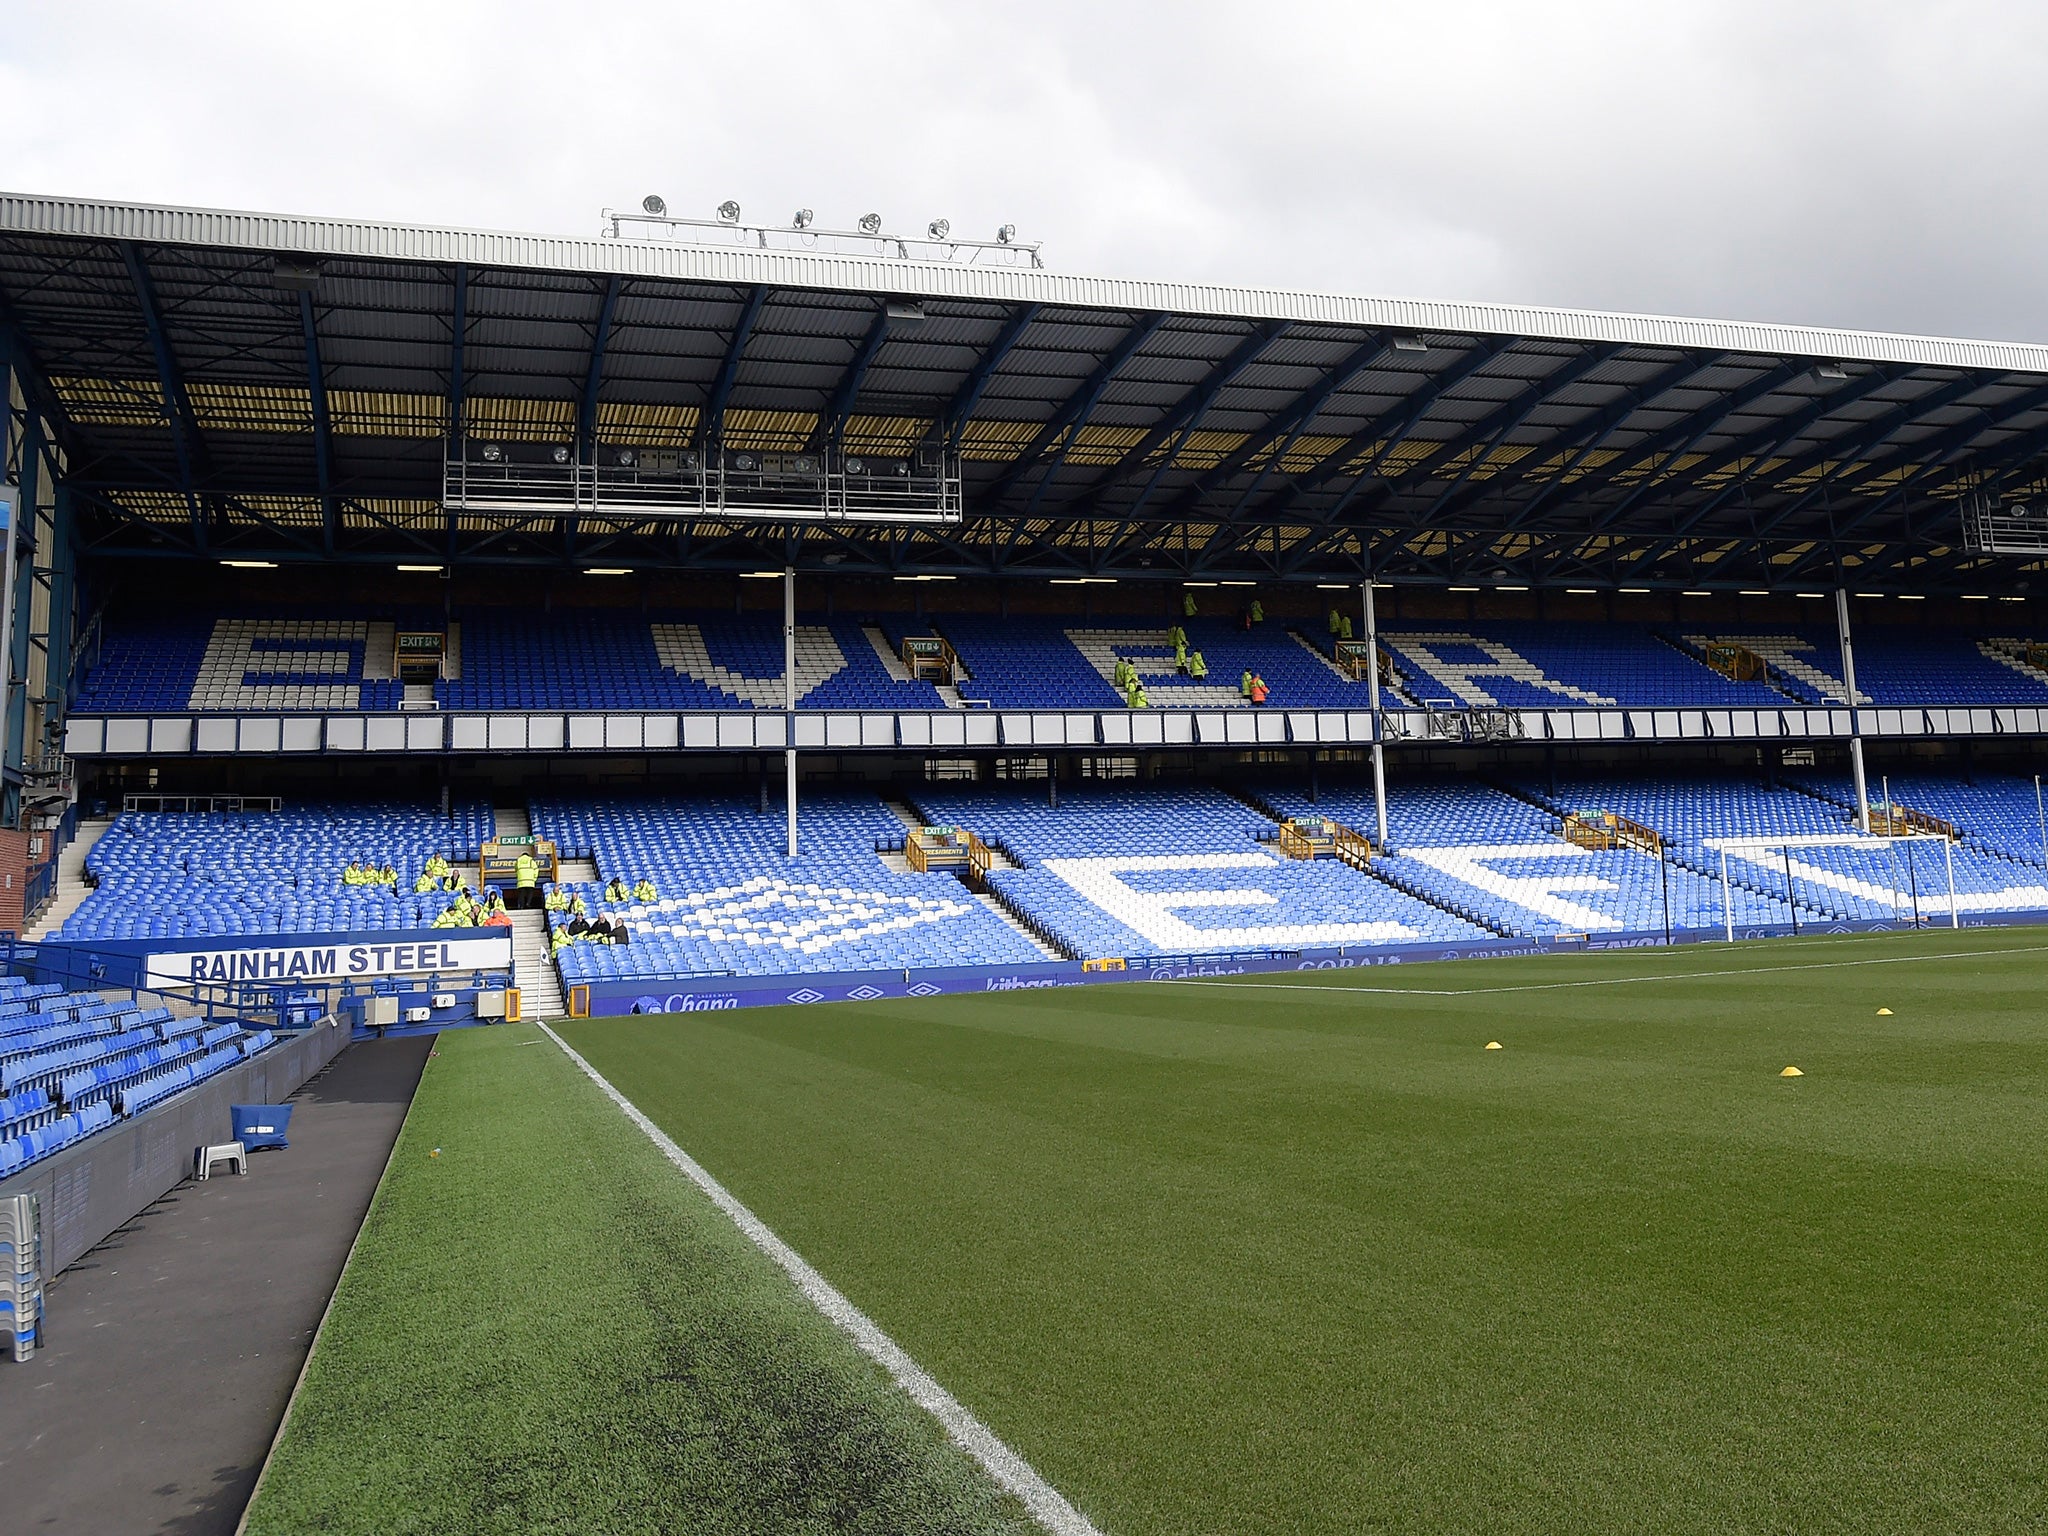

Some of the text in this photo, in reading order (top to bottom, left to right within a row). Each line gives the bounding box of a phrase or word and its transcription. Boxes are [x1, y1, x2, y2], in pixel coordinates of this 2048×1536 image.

[400, 636, 424, 647] EXIT
[191, 944, 459, 981] RAINHAM STEEL
[664, 993, 738, 1013] Chang
